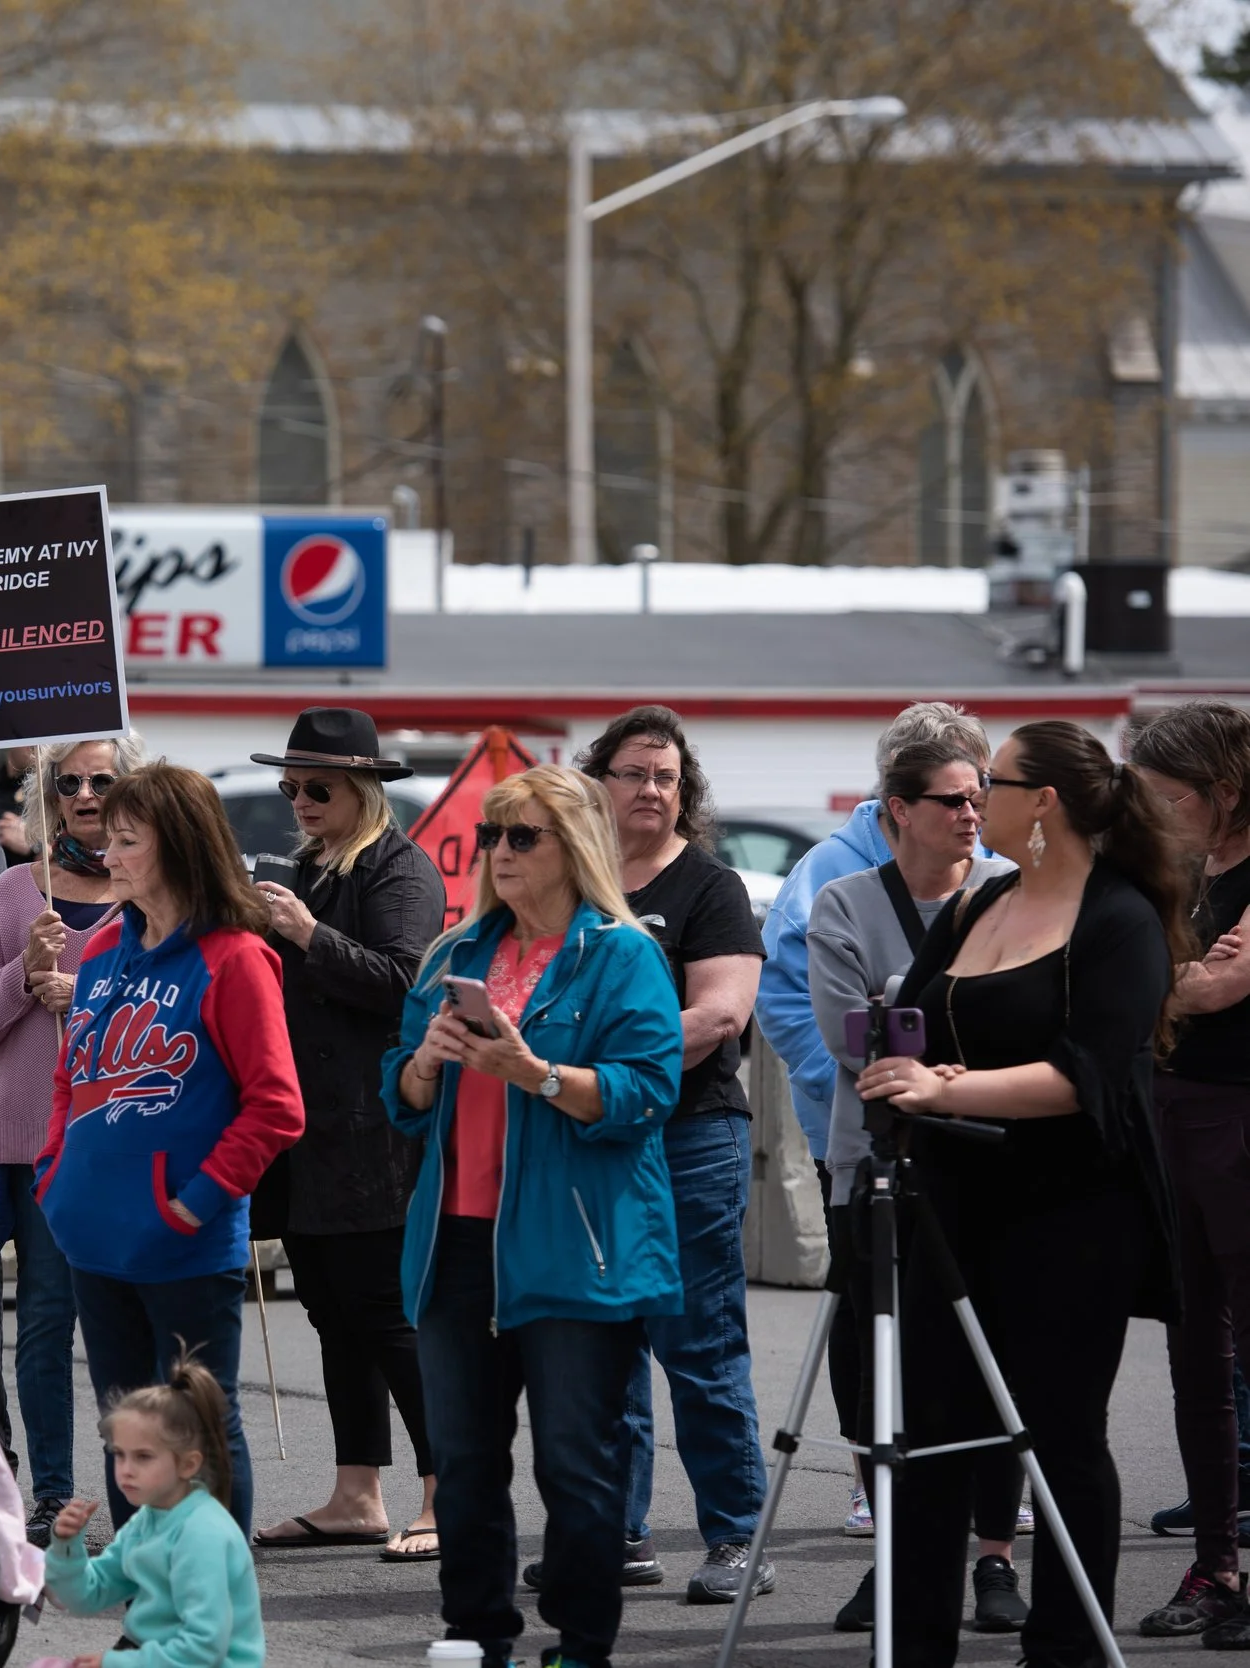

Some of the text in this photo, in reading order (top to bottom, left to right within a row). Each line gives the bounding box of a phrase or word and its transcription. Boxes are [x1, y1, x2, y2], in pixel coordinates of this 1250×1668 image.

[37, 543, 63, 561] AT
[67, 539, 99, 558] IVY
[88, 974, 180, 1008] BUALO
